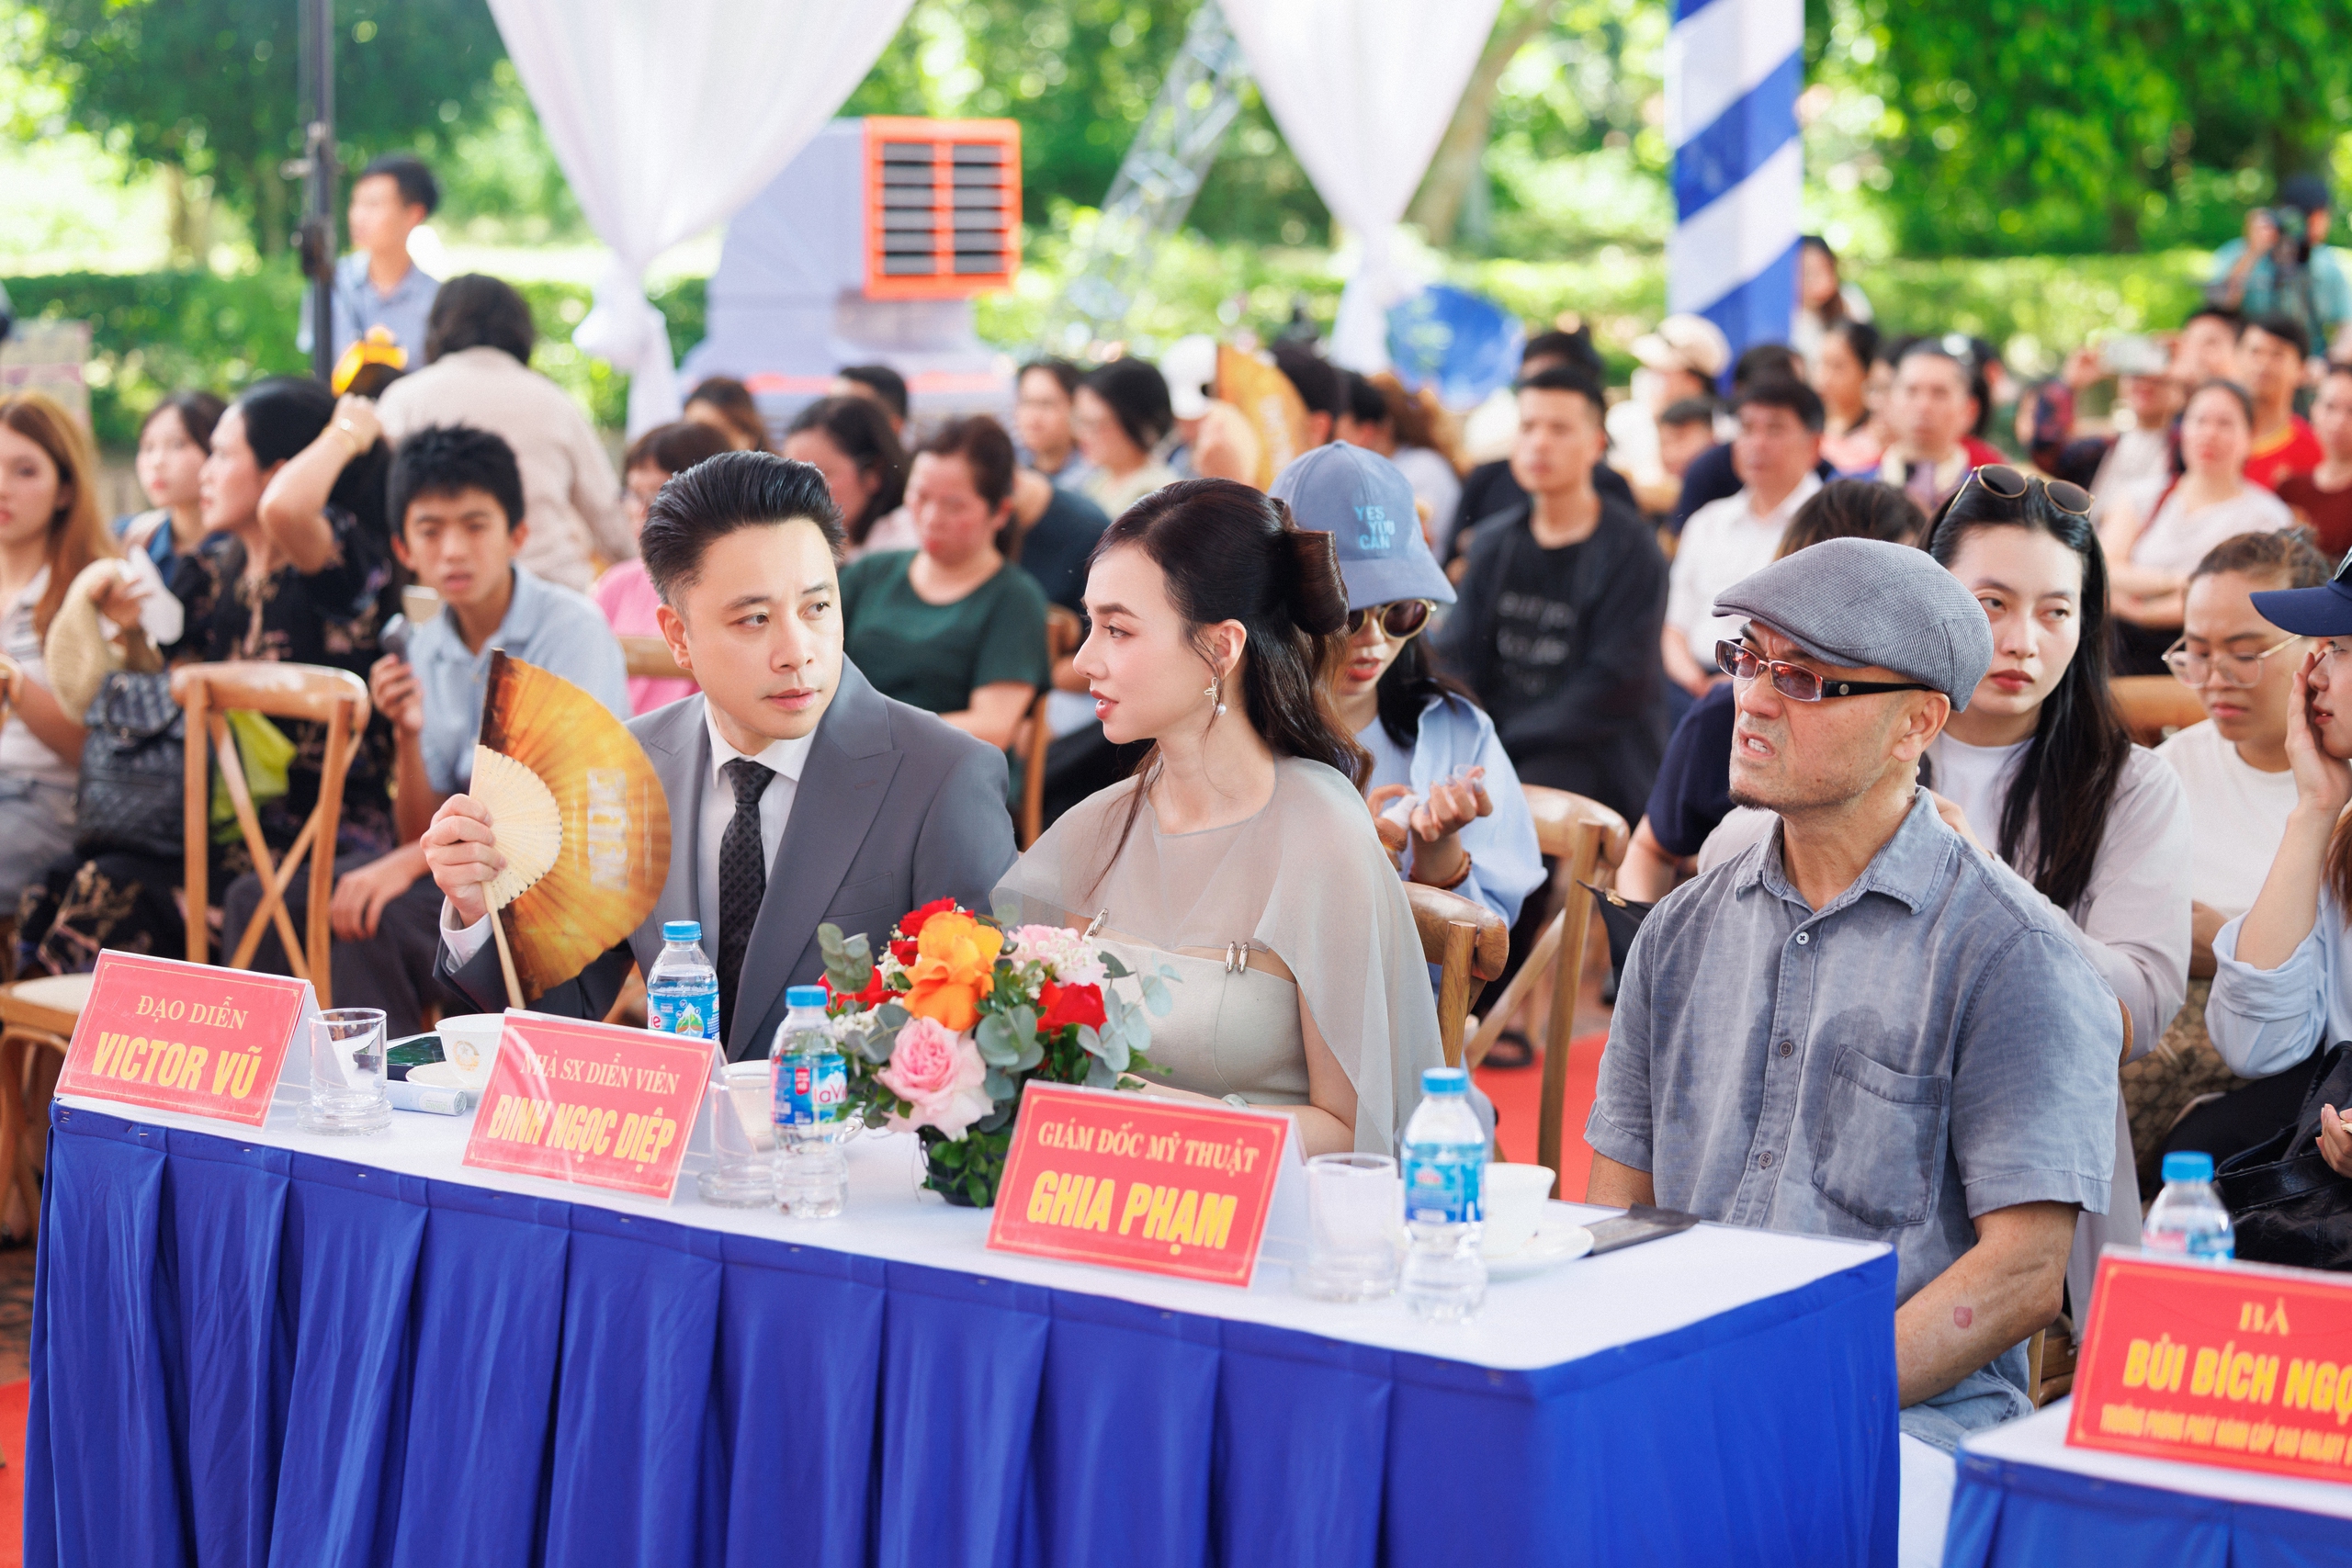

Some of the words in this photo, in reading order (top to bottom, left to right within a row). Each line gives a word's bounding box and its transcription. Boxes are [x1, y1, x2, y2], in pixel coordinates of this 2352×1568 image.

[1354, 505, 1385, 521] YES
[1368, 520, 1396, 536] YOU
[1359, 534, 1390, 549] CAN
[136, 995, 186, 1024] ĐẠO
[188, 996, 248, 1030] DIỄN
[91, 1032, 208, 1090] VICTOR
[210, 1045, 263, 1100] VŨ
[519, 1050, 557, 1077] NHÀ
[560, 1057, 586, 1082] SX
[636, 1065, 680, 1095] VIÊN
[546, 1102, 618, 1163] NGỌC
[613, 1107, 677, 1173] DIỆP
[1037, 1117, 1094, 1152] GIÁM
[1096, 1121, 1145, 1158] ĐỐC
[1185, 1138, 1260, 1177] THUẬT
[1026, 1170, 1115, 1233] GHIA
[1118, 1181, 1238, 1256] PHẠM
[2189, 1340, 2279, 1405] BÍCH
